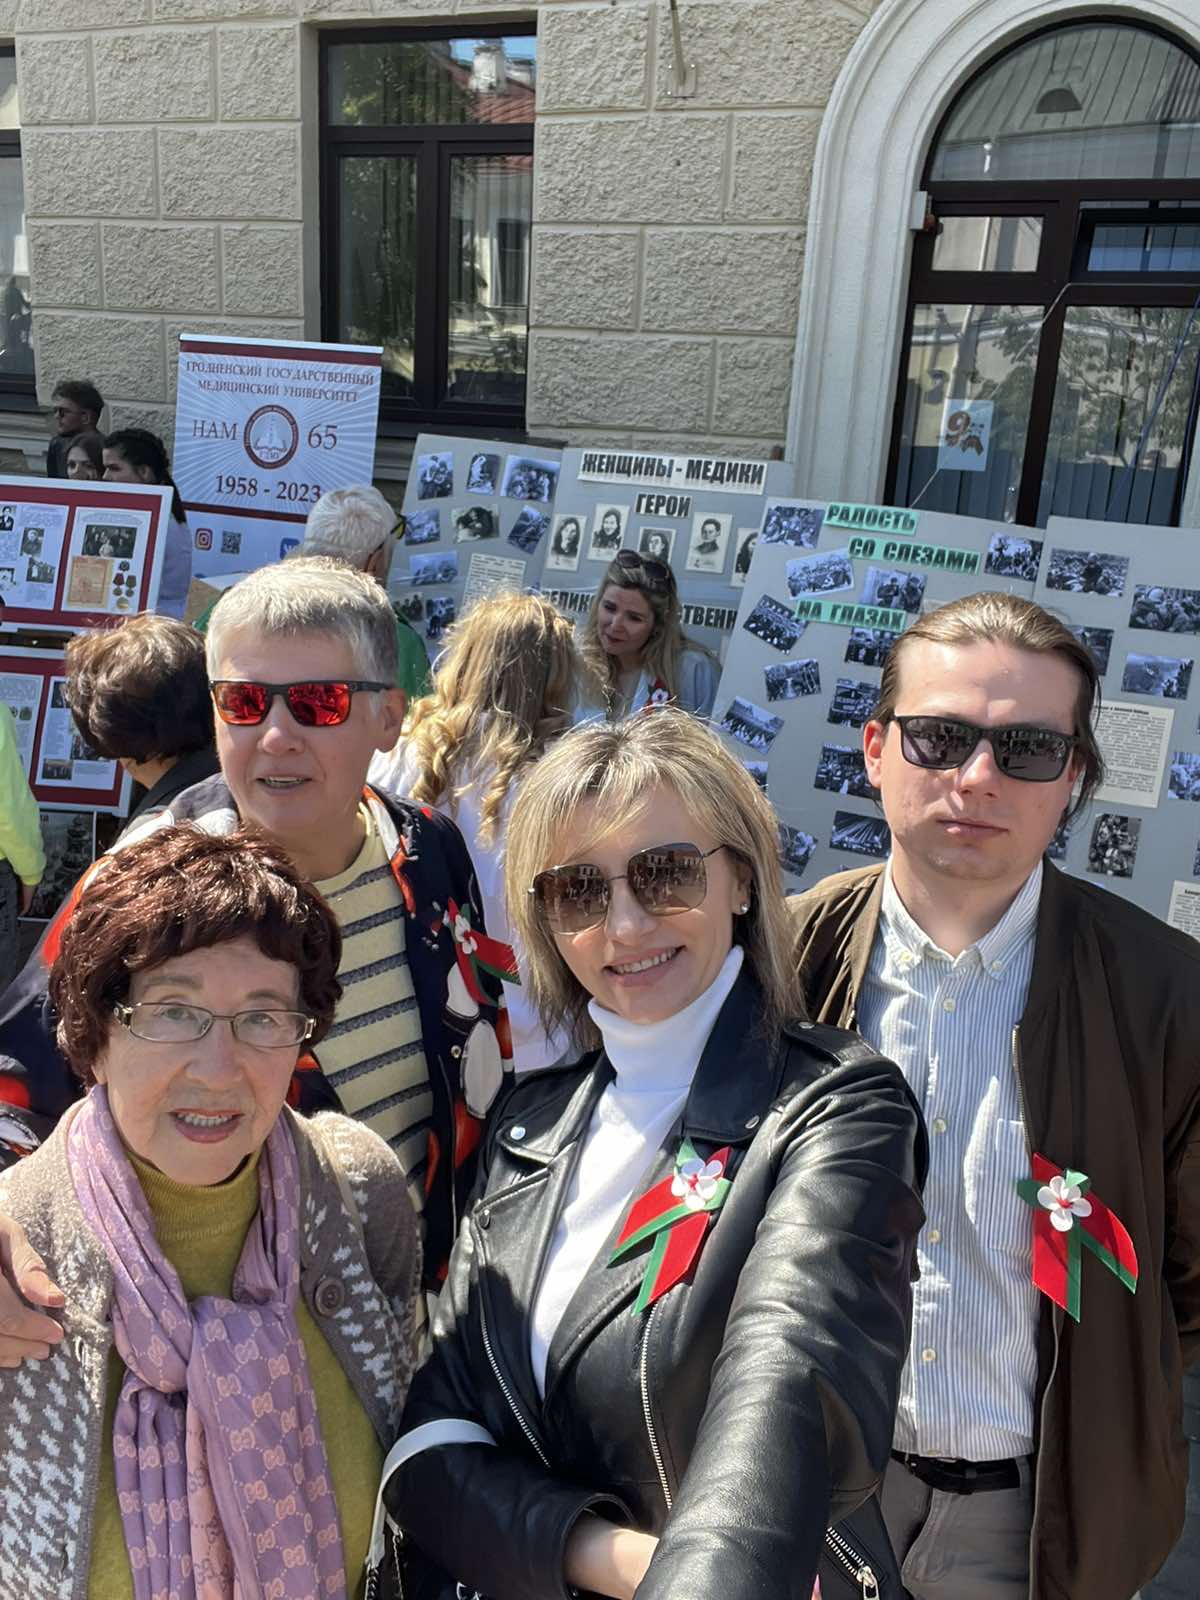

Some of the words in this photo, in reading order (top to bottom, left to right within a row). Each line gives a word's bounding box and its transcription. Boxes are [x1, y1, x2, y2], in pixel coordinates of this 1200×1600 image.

[186, 361, 262, 377] ГРОДНЕНСКИЙ
[266, 366, 374, 385] ГОСУДАРСТВЕННЫЙ
[198, 380, 279, 396] МЕДИЦИНСКИЙ
[283, 386, 359, 402] УНИВЕРСИТЕТ
[192, 419, 238, 441] НАМ
[308, 423, 338, 450] 65
[582, 453, 675, 479] ЖЕНЩИНЫ
[685, 459, 765, 485] МЕДИКИ
[215, 475, 258, 497] 1958
[276, 481, 322, 503] 2023
[635, 493, 692, 518] ГЕРОИ
[826, 504, 915, 531] РАДОСТЬ
[850, 537, 876, 558] СО
[883, 541, 979, 573] СЛЕЗАМИ
[797, 600, 823, 619] НА
[831, 603, 905, 630] ГЛАЗАХ
